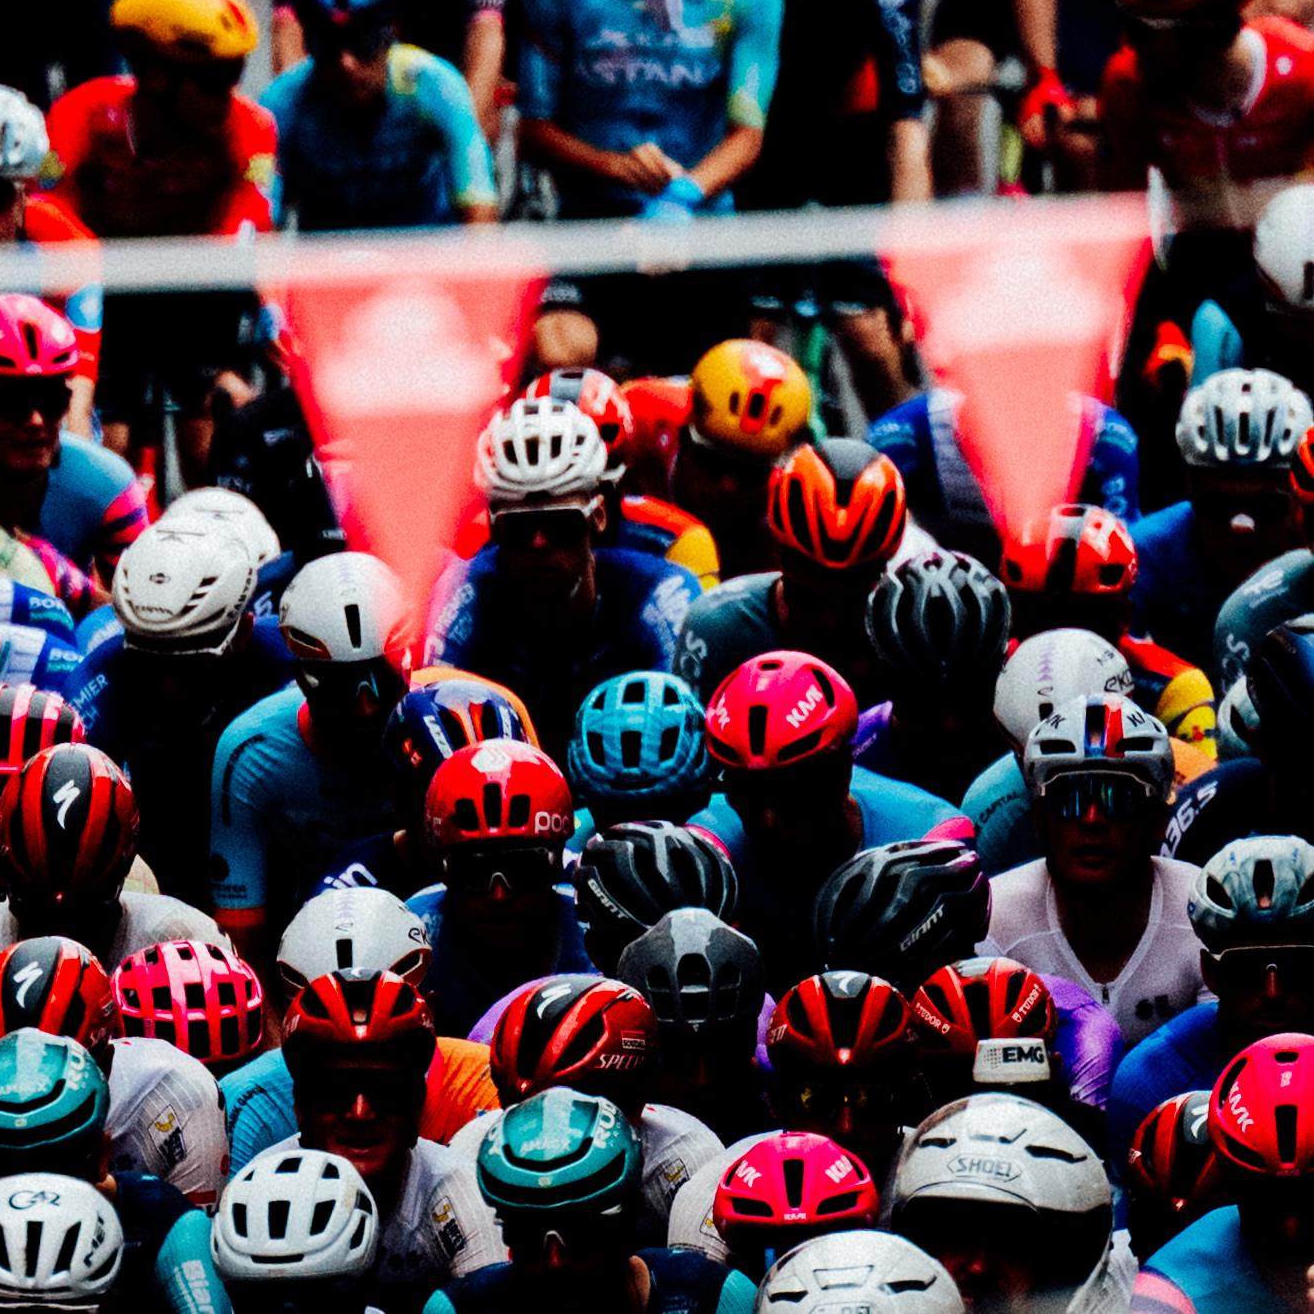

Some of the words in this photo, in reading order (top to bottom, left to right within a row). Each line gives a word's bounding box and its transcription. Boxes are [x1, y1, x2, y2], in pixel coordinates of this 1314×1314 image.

[979, 790, 1022, 825] CAPITAL
[1018, 985, 1040, 1016] TUDOR
[917, 1003, 942, 1029] TUDOR
[1001, 1045, 1046, 1064] EMG
[956, 1157, 1012, 1178] SHOEI
[8, 1190, 61, 1210] G42
